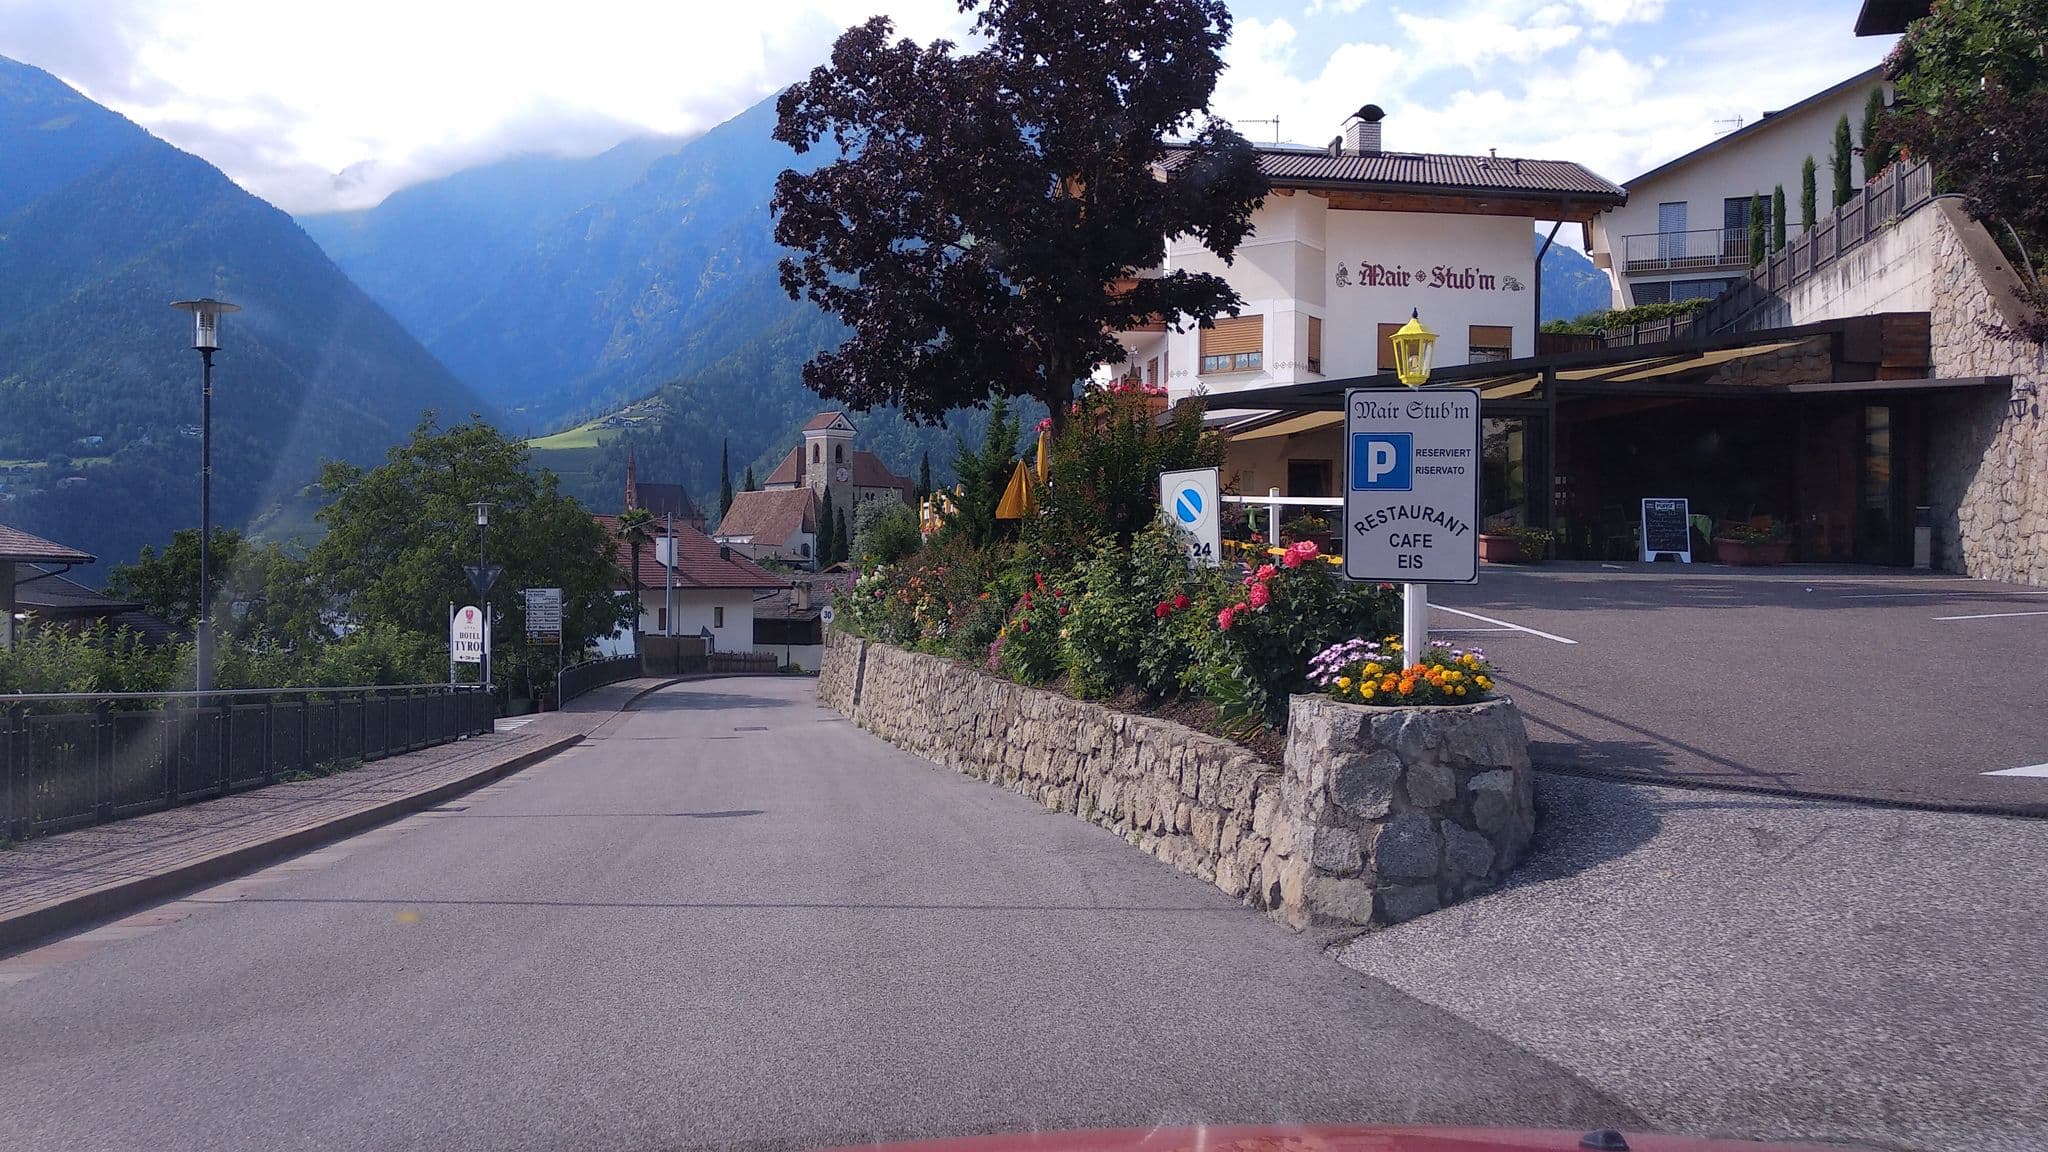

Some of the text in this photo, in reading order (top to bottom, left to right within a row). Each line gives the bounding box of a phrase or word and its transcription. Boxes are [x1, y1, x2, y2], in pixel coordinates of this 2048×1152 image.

[1358, 261, 1411, 287] Mair
[1354, 401, 1400, 420] Mair
[1415, 448, 1472, 458] RESERVIERT
[1367, 441, 1397, 483] P
[1415, 466, 1465, 475] RISERVATO
[1354, 504, 1470, 538] RESTAURANT
[1389, 533, 1433, 549] CAFE
[1193, 542, 1212, 557] 24
[1398, 554, 1424, 570] EIS
[823, 610, 832, 619] 30
[459, 632, 480, 640] HOTEL
